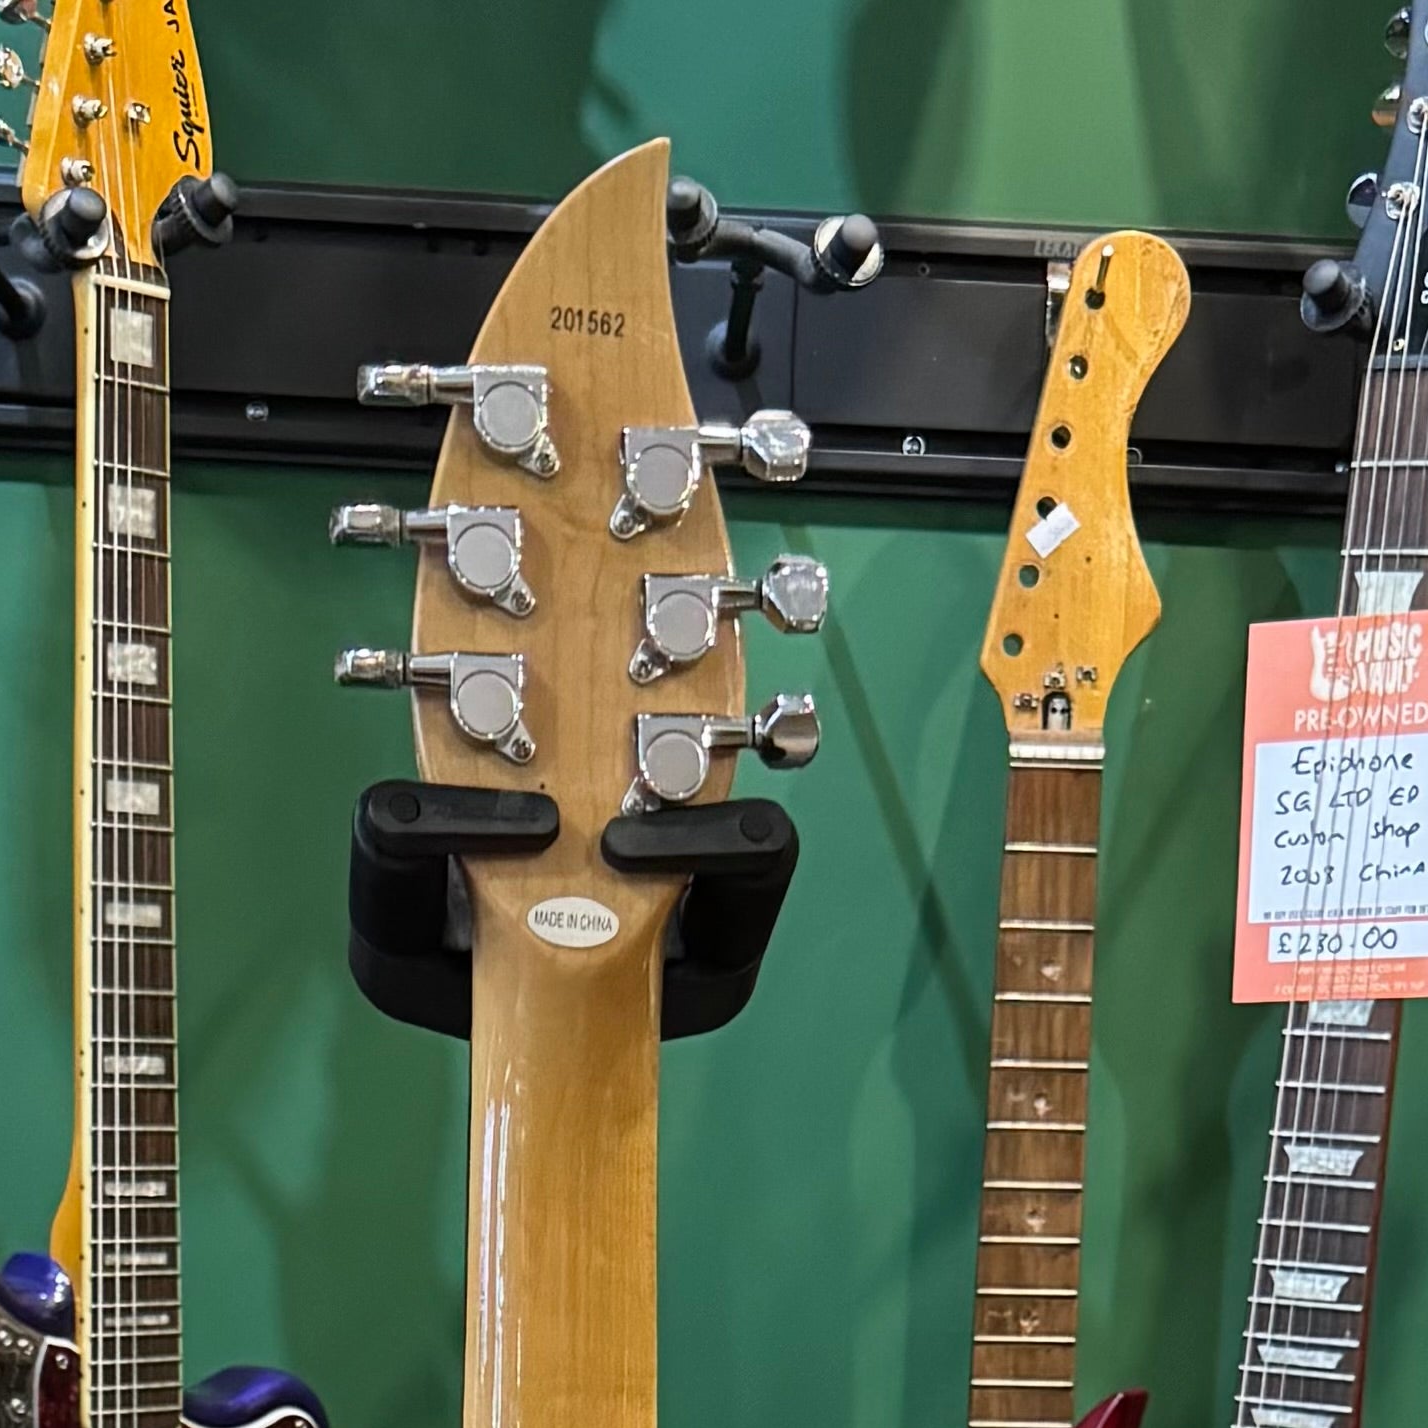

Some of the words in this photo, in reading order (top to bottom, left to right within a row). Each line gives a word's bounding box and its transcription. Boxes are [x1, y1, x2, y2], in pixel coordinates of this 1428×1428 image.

[171, 49, 205, 171] Squier
[551, 305, 626, 338] 201562
[1355, 620, 1423, 662] MUSIC
[1352, 658, 1420, 698] VAULT
[1291, 746, 1414, 785] Epiphone
[1274, 790, 1313, 817] SG
[1328, 787, 1373, 809] LTD
[1358, 862, 1426, 883] China
[534, 910, 565, 929] MADE
[566, 912, 578, 930] IN
[579, 913, 613, 932] CHINA
[1276, 925, 1398, 955] £230.00
